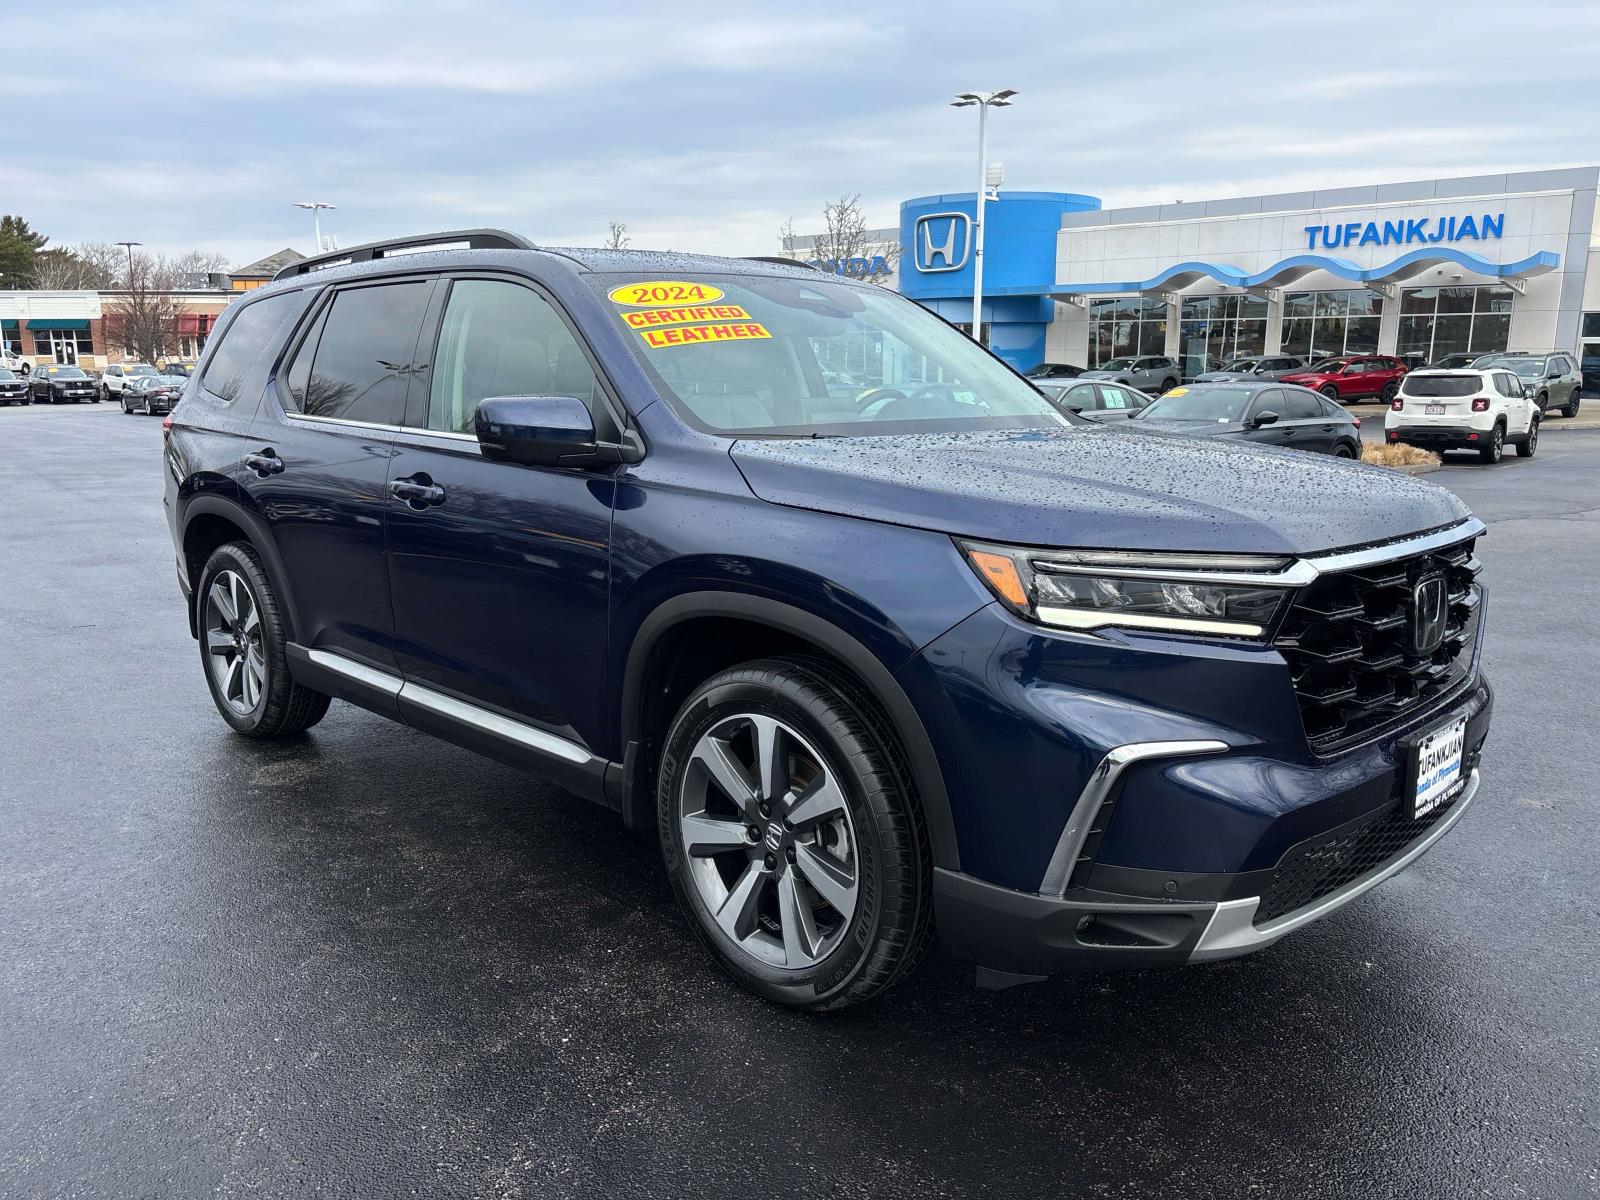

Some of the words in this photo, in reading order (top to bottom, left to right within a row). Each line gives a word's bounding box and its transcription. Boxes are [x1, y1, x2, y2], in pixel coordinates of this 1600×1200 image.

[1305, 213, 1505, 250] TUFANKJIAN
[805, 255, 894, 277] NDA
[632, 285, 708, 304] 2024
[627, 306, 744, 327] CERTIFIED
[646, 324, 767, 347] LEATHER
[1414, 800, 1434, 820] HONDA
